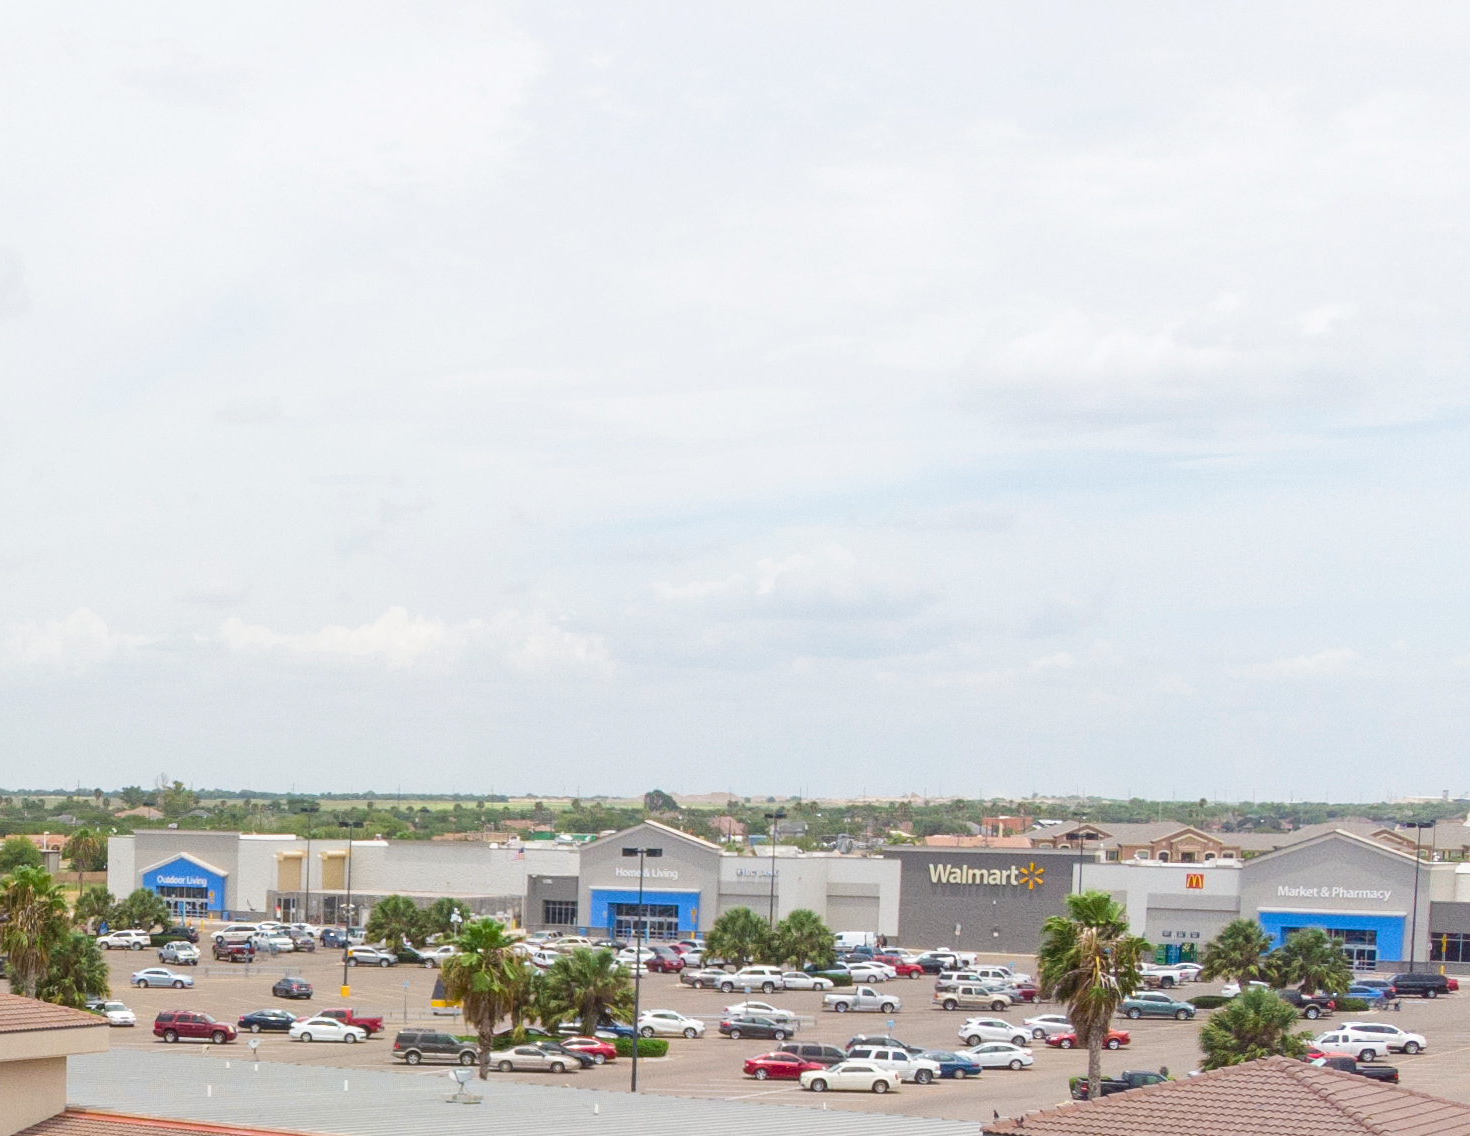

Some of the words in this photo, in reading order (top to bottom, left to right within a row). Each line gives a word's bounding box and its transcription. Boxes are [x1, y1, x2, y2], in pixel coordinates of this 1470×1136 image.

[615, 867, 641, 878] Home
[651, 868, 678, 880] Living
[929, 864, 1018, 885] Walmart
[157, 876, 185, 884] Outdoor
[187, 876, 207, 887] Living
[1277, 885, 1318, 898] Market
[1320, 886, 1330, 898] &
[1332, 886, 1391, 901] Pharmacy
